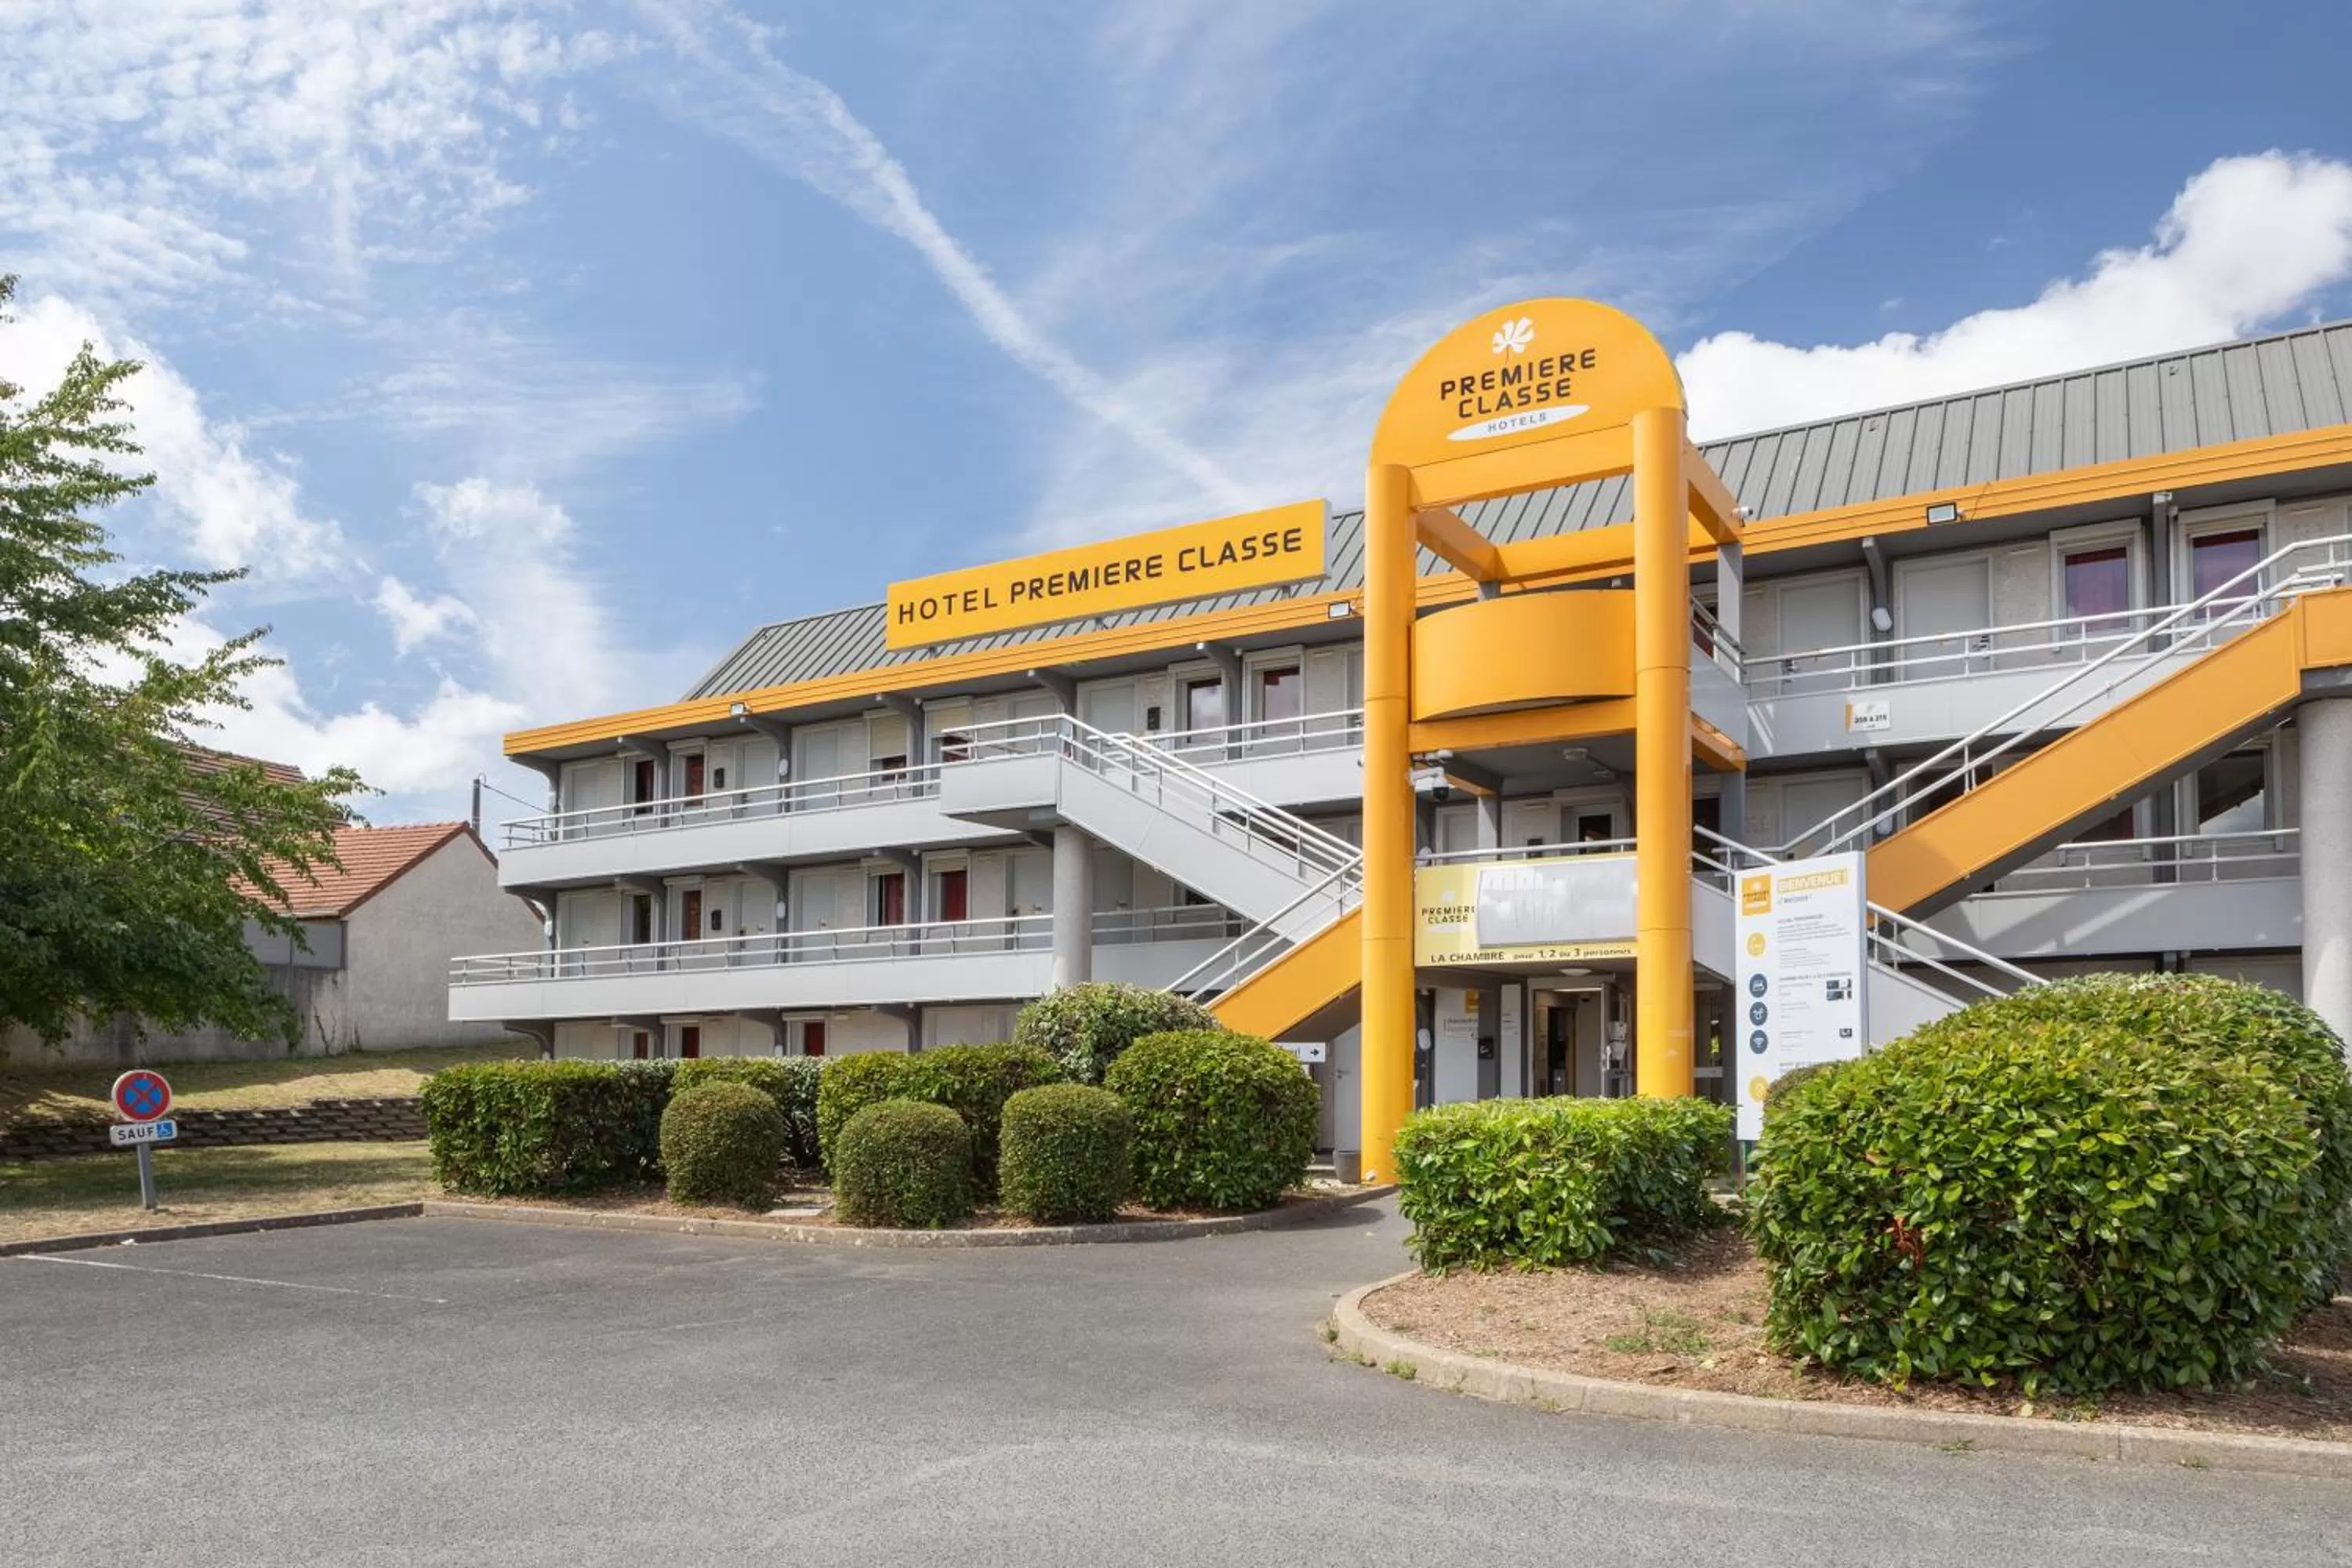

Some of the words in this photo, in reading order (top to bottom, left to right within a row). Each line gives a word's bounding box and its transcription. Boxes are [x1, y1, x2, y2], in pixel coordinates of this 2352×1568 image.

[1440, 348, 1596, 400] PREMIERE
[1458, 377, 1572, 419] CLASSE
[1488, 412, 1548, 433] HOTELS
[898, 587, 998, 625] HOTEL
[1010, 554, 1163, 604] PREMIERE
[1178, 527, 1302, 572] CLASSE
[1428, 914, 1468, 924] CLASSE
[1431, 954, 1446, 963] LA
[1450, 951, 1504, 962] CHAMBRE
[1549, 949, 1556, 958] 2
[1574, 948, 1581, 957] 3
[118, 1127, 154, 1141] SAUF
